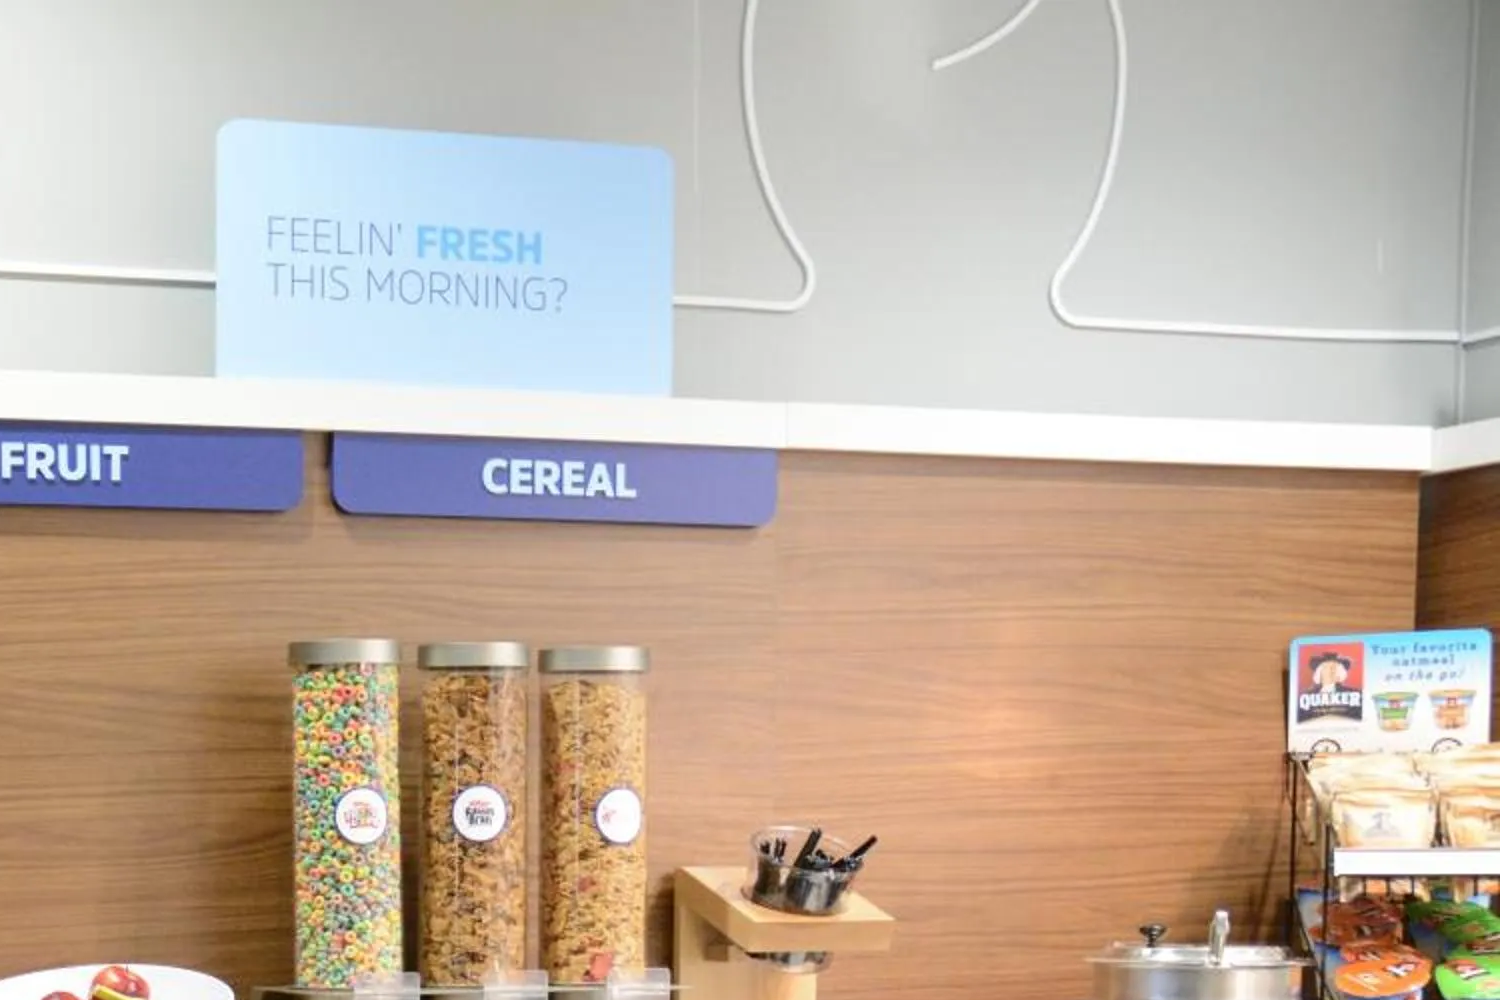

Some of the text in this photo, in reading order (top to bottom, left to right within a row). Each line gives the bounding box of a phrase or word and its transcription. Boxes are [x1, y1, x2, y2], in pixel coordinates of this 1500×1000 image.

[266, 215, 543, 265] FEELIN' FRESH
[266, 262, 569, 313] THIS MORNING?
[0, 441, 129, 483] FRUIT
[482, 457, 637, 500] CEREAL
[1299, 690, 1362, 711] QUAKER
